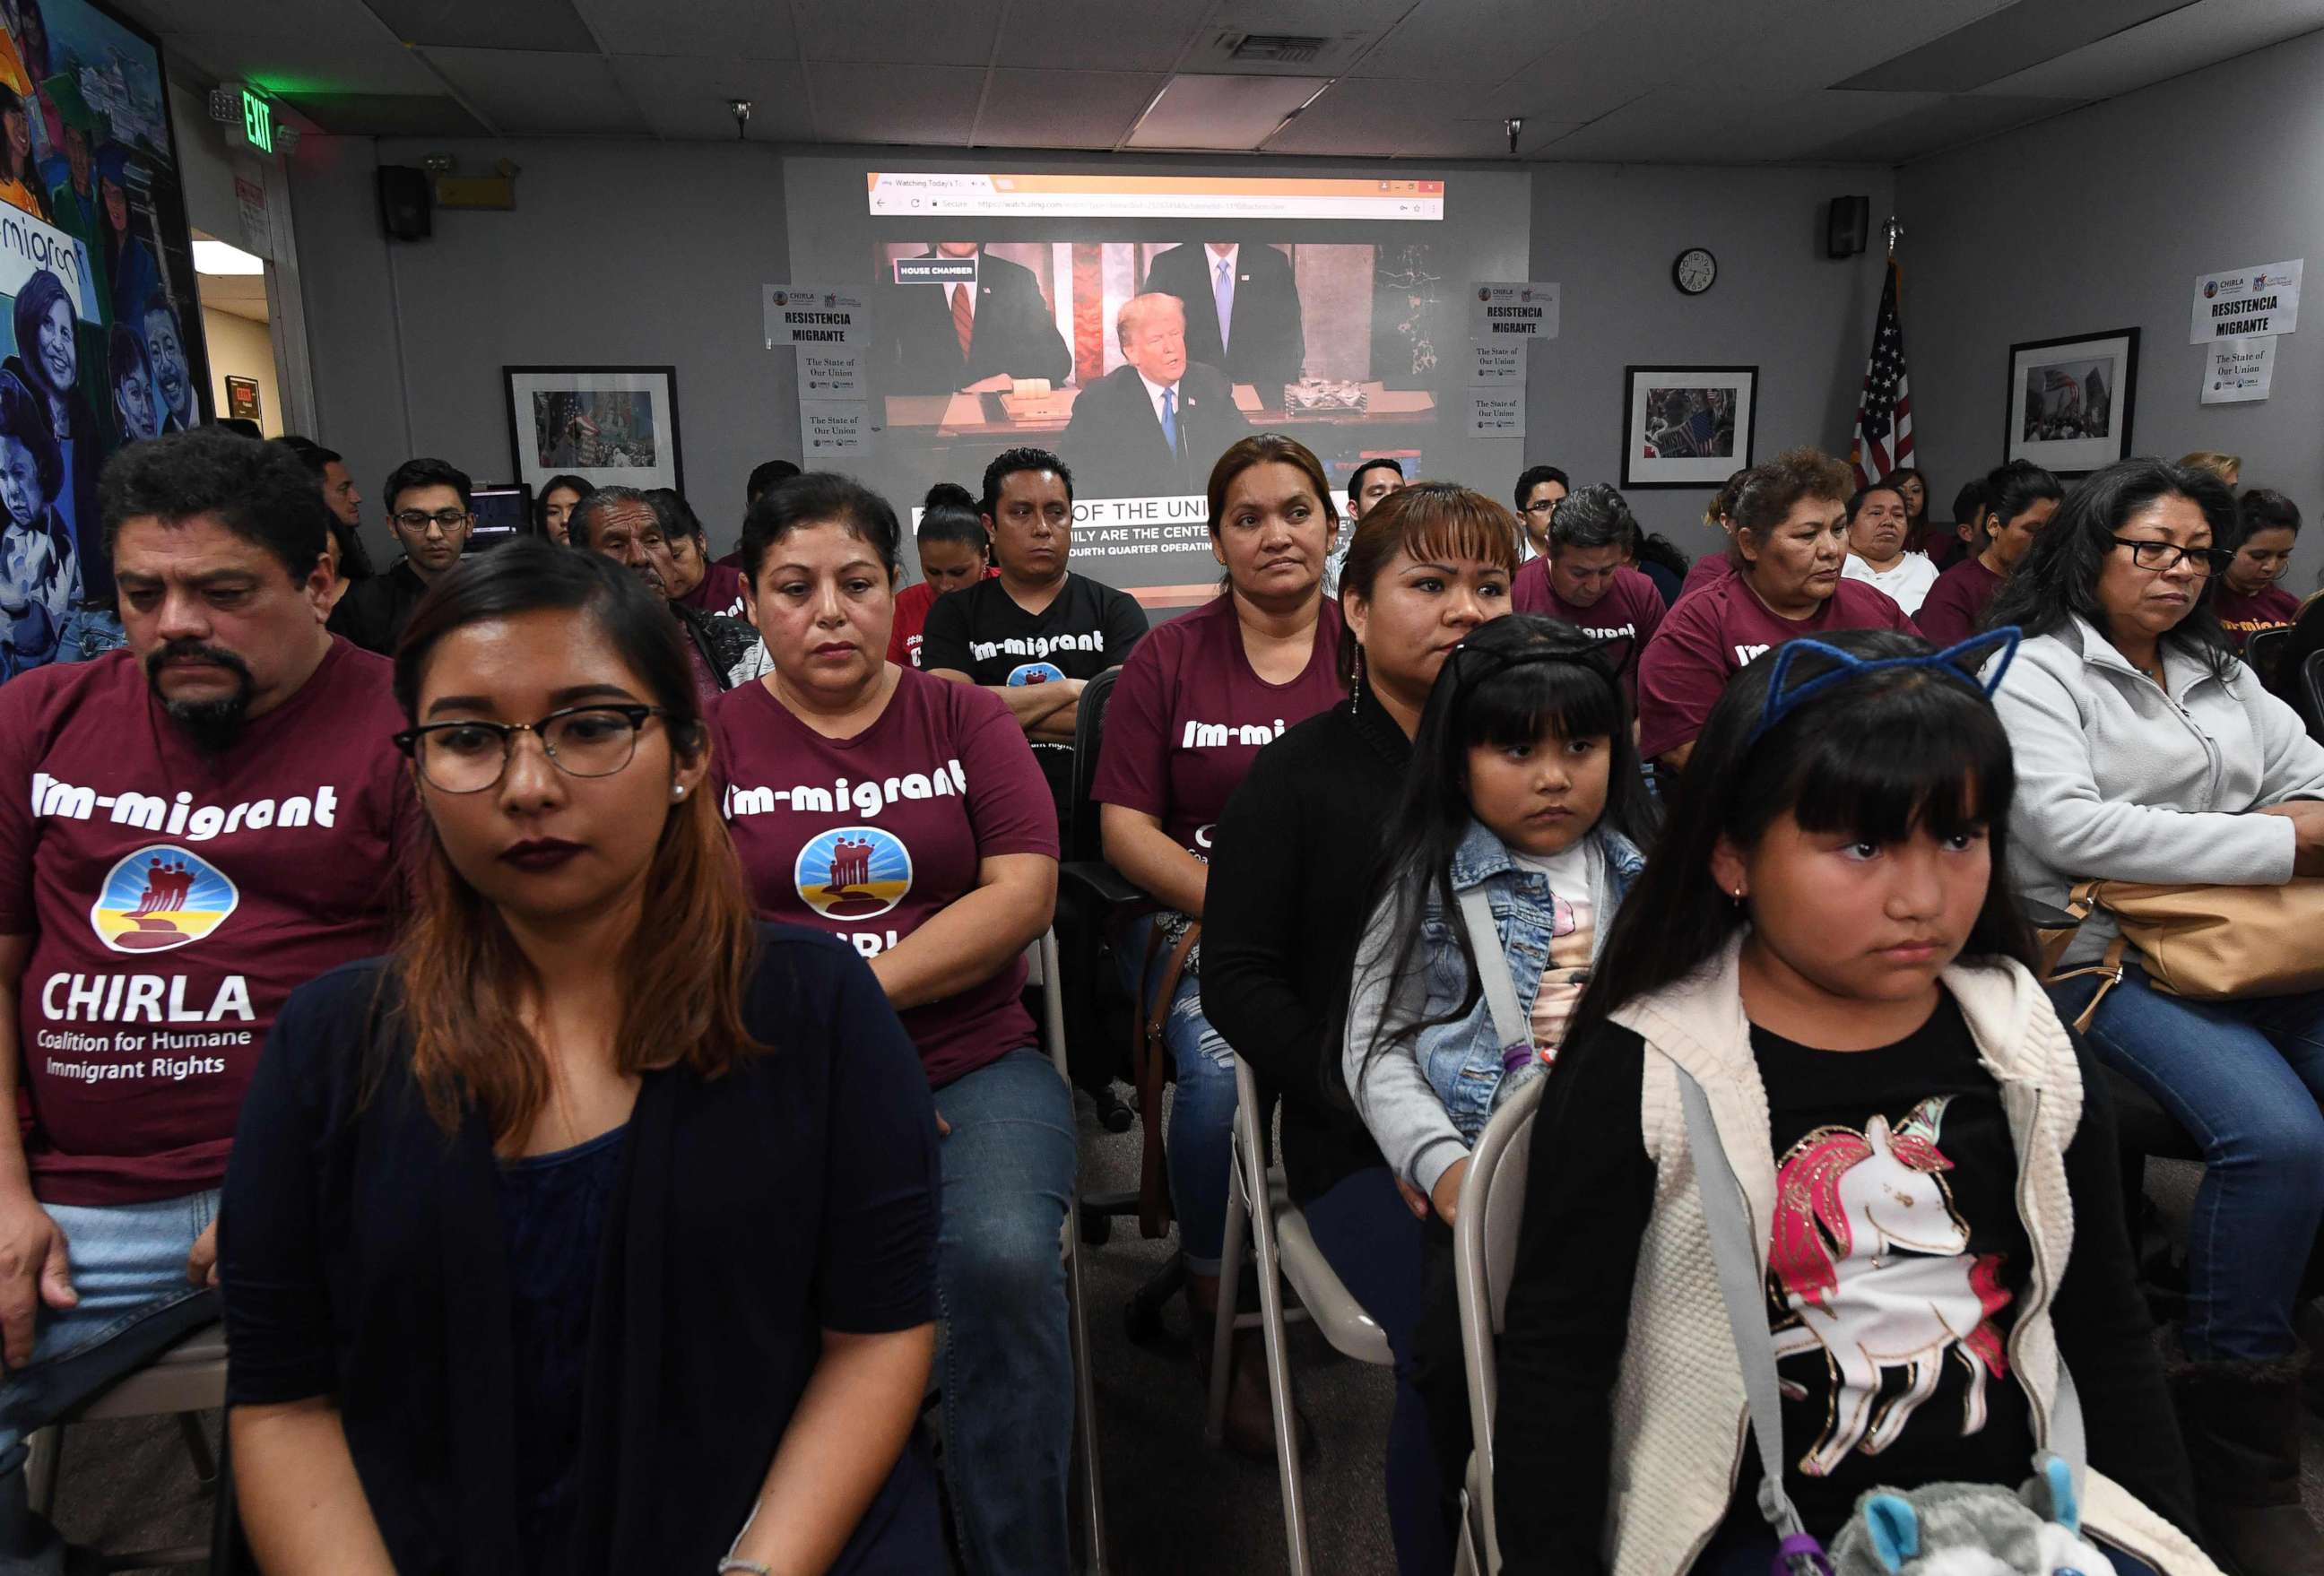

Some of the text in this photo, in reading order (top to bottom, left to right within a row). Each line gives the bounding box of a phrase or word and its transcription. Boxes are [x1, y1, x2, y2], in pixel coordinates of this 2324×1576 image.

[243, 91, 272, 153] EXIT
[895, 179, 926, 188] Watching
[900, 266, 973, 274] HOUSE CHAMBER
[2220, 278, 2244, 289] CHIRLA
[1487, 307, 1542, 317] RESISTENCIA
[2211, 295, 2278, 317] RESISTENCIA
[785, 311, 851, 325] RESISTENCIA
[1492, 323, 1537, 333] MIGRANTE
[2216, 317, 2268, 337] MIGRANTE
[793, 329, 845, 342] MIGRANTE
[1491, 347, 1509, 355] State
[1511, 347, 1519, 355] of
[2216, 350, 2266, 364] The State of
[806, 358, 854, 367] The State of
[810, 368, 853, 377] Our Union
[2217, 363, 2259, 376] Our Union
[1476, 400, 1489, 408] The
[1490, 400, 1507, 408] State
[810, 416, 859, 424] The State of
[814, 426, 856, 435] Our Union
[1072, 504, 1104, 522] OF
[1113, 502, 1158, 520] THE
[1100, 529, 1129, 541] ARE
[1132, 528, 1159, 540] THE
[1108, 544, 1158, 556] QUARTER
[41, 972, 256, 1023] CHIRLA
[37, 1028, 252, 1052] Coalition for Humane
[47, 1055, 225, 1084] Immigrant Rights
